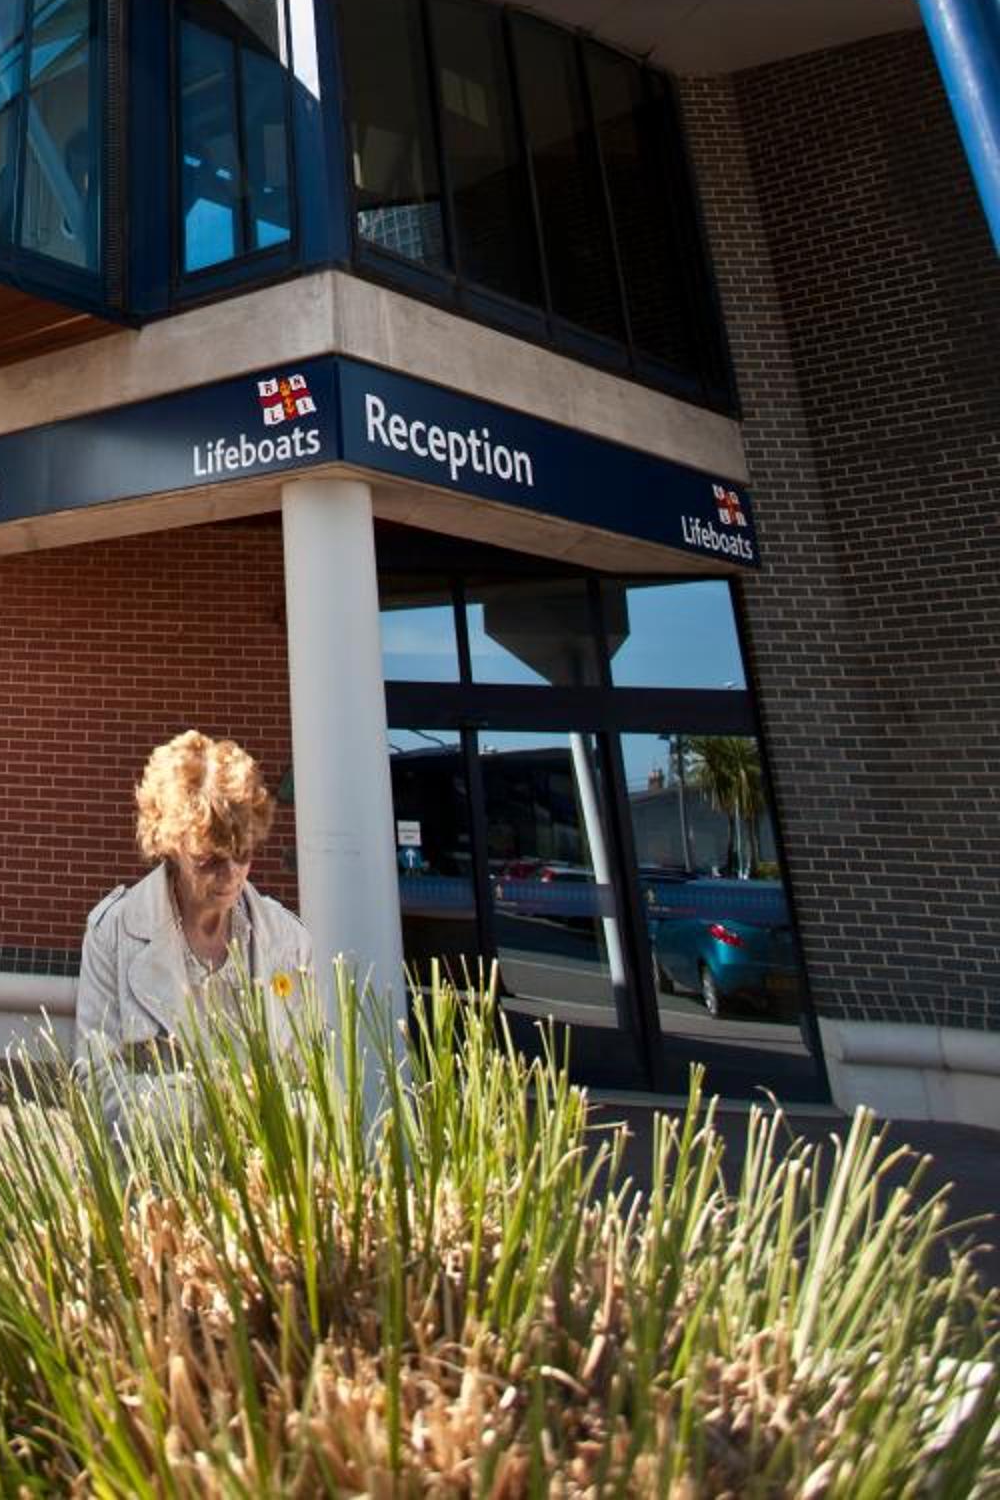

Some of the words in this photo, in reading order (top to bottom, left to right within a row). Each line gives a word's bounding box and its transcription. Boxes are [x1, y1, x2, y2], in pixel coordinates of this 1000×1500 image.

[194, 427, 321, 476] Lifeboats
[365, 393, 534, 486] Reception
[681, 515, 753, 559] Lifeboats
